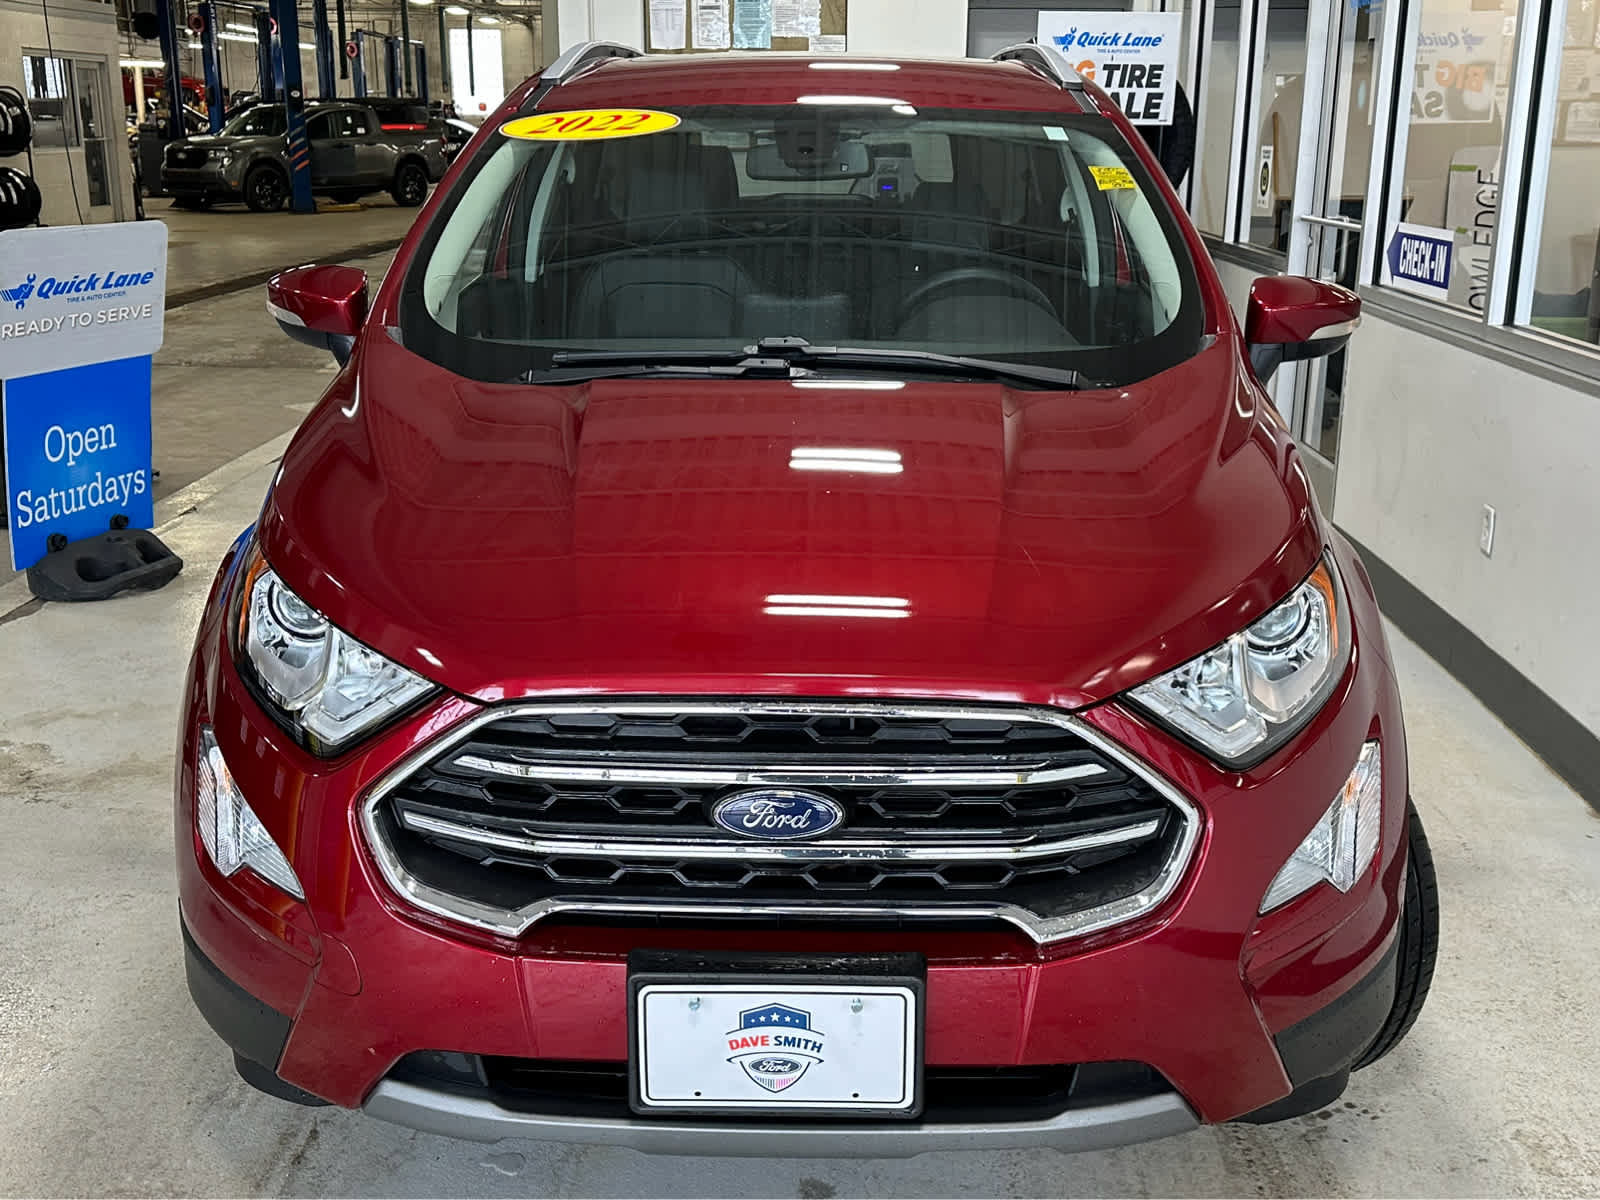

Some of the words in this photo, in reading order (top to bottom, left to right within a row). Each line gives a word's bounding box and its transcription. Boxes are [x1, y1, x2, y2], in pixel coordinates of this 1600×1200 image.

[1077, 31, 1122, 48] Quick
[1122, 32, 1163, 47] Lane
[1102, 63, 1165, 89] TIRE
[1109, 92, 1164, 120] ALE
[527, 113, 652, 135] 2022
[1399, 236, 1448, 284] CHECK-IN
[37, 272, 102, 299] Quick
[101, 270, 155, 290] Lane
[1, 315, 66, 340] READY
[68, 311, 93, 329] TO
[97, 303, 153, 324] SERVE
[44, 423, 117, 467] Open
[16, 469, 146, 529] Saturdays
[742, 800, 813, 829] Ford
[728, 1034, 770, 1051] DAVE
[773, 1035, 824, 1054] SMITH
[759, 1059, 792, 1073] Ford
